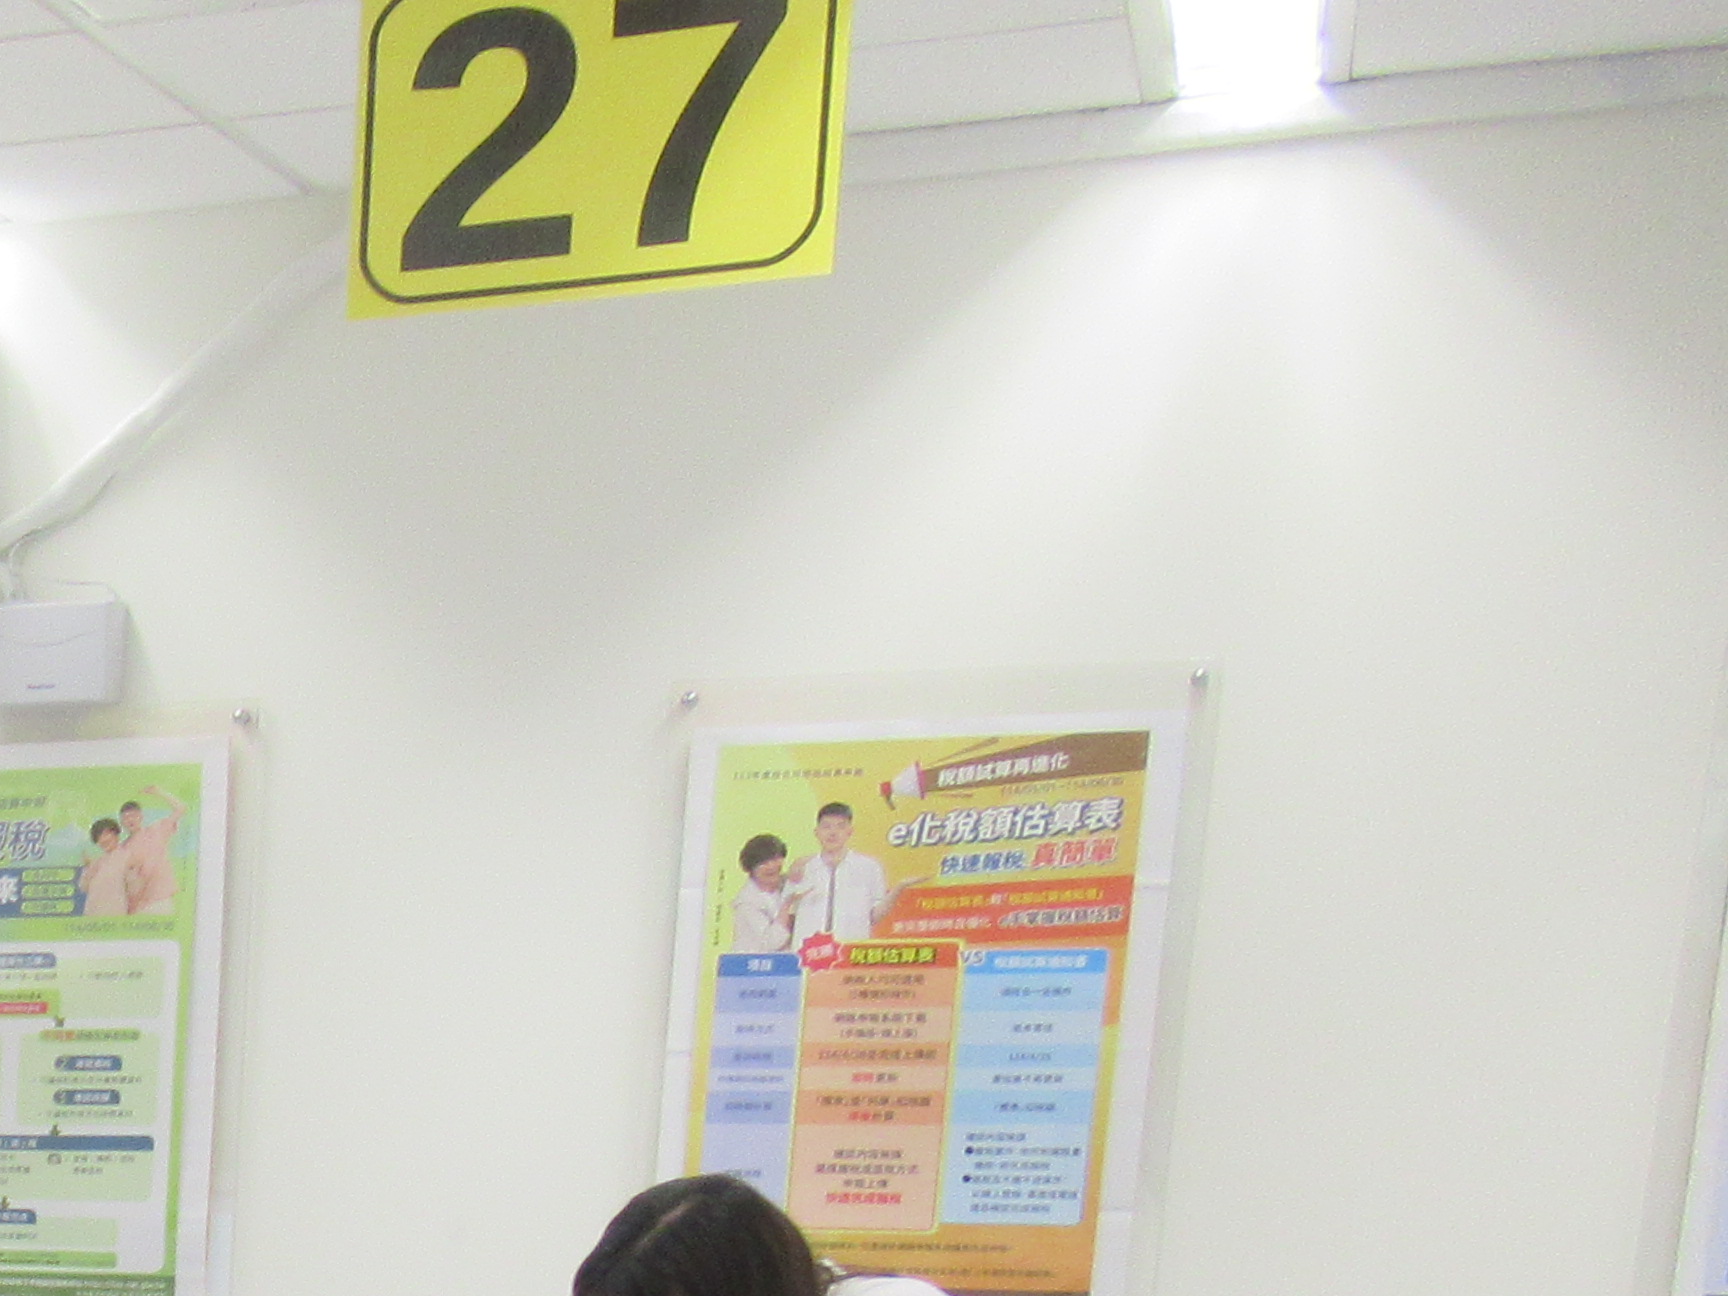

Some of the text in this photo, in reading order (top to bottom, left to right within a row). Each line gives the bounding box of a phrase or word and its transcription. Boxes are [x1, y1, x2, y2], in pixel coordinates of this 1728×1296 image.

[400, 0, 787, 272] 27
[888, 796, 1125, 848] e化稅額估算表
